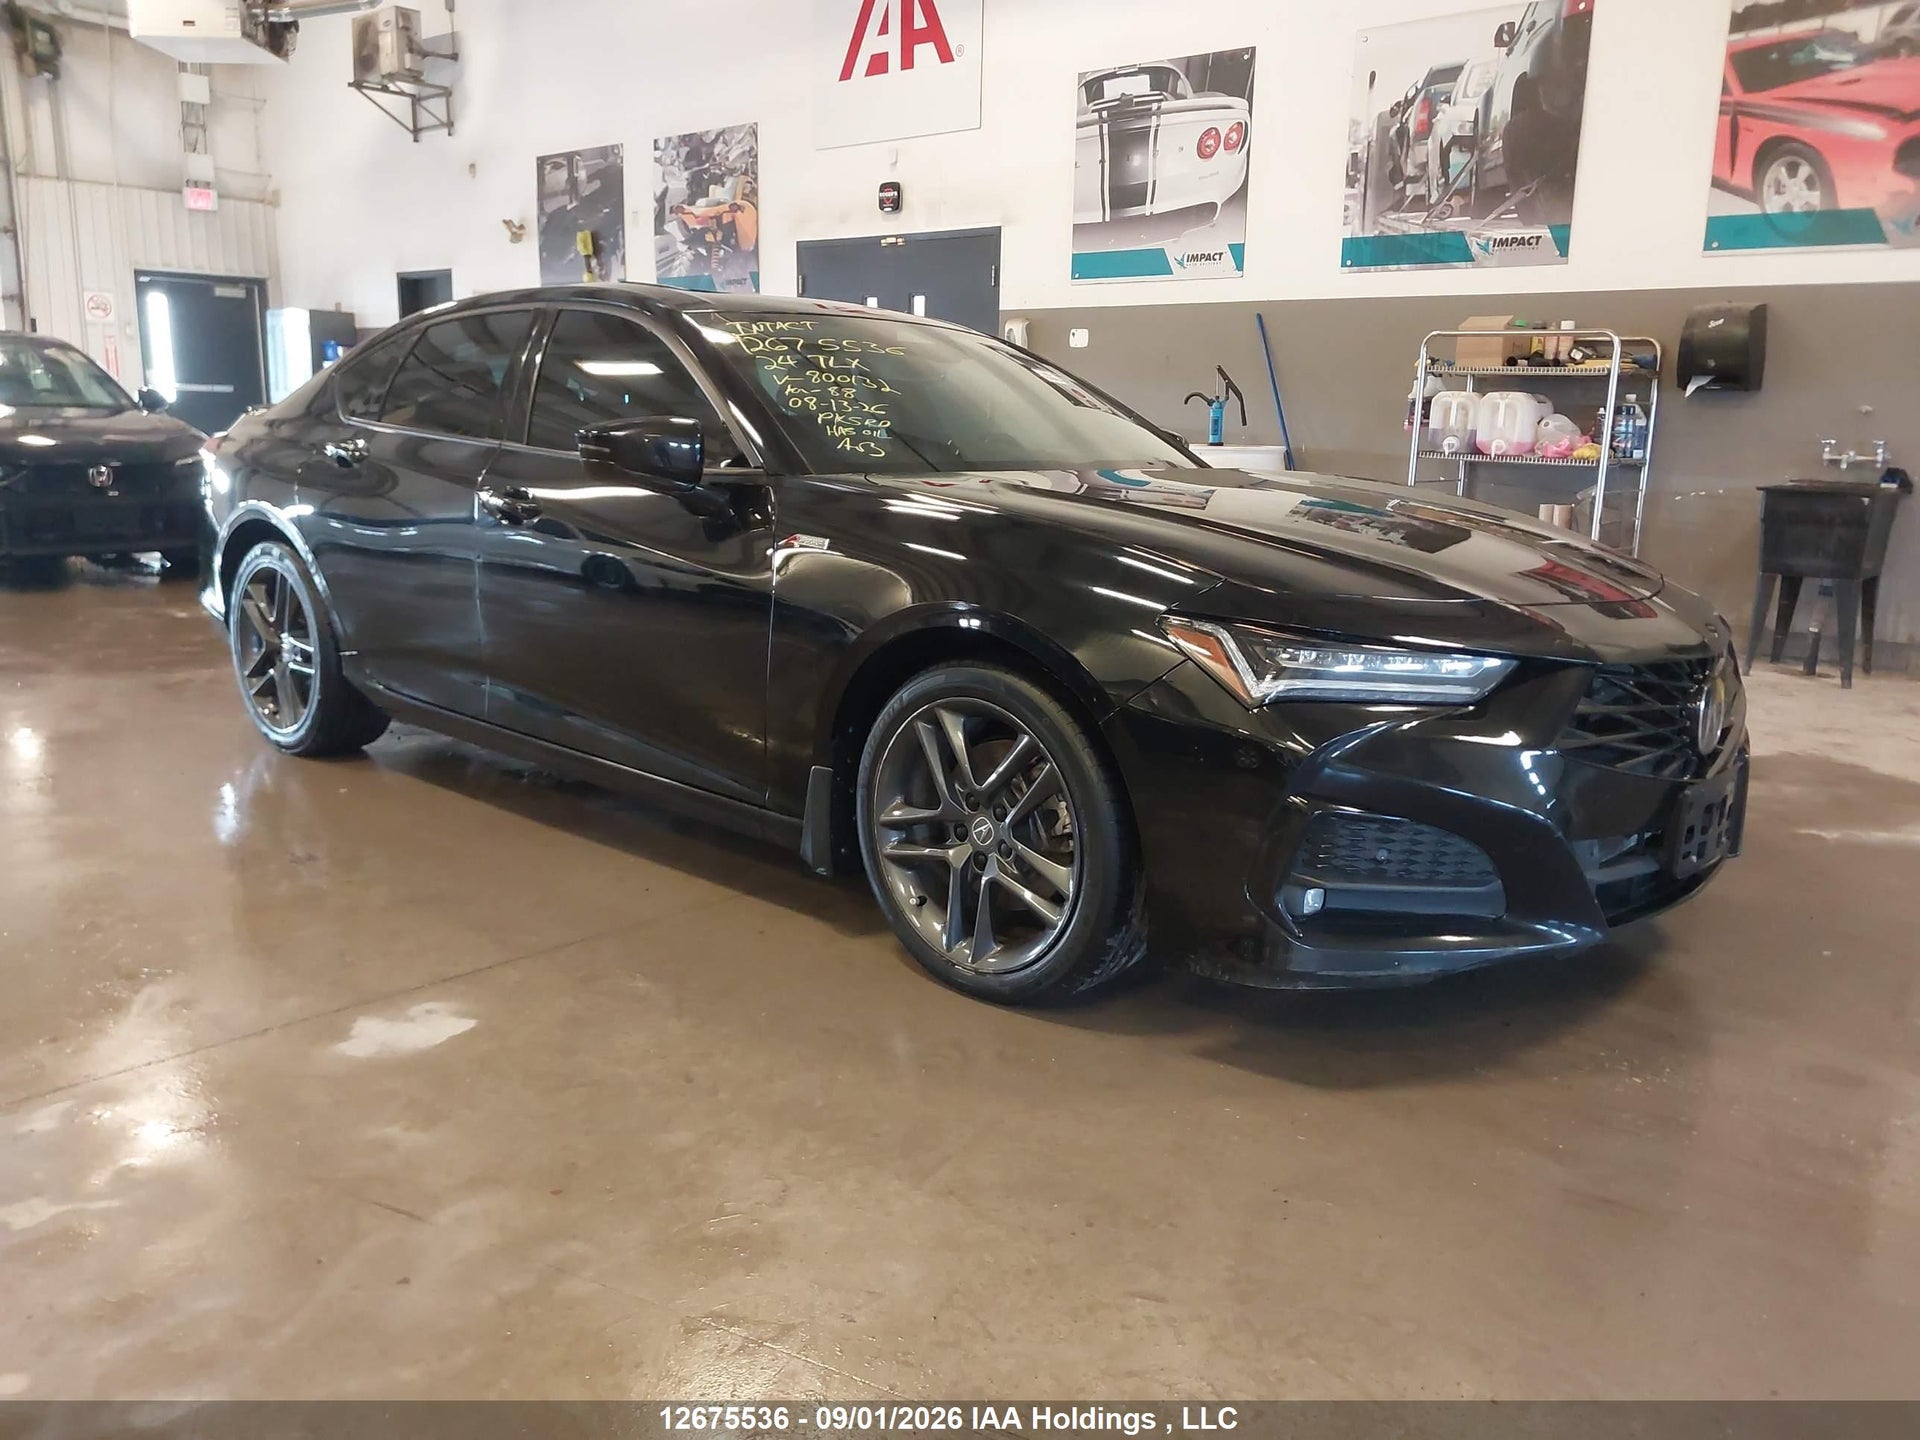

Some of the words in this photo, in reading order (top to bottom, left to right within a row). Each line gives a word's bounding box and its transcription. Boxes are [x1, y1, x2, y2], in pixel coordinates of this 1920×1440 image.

[1491, 235, 1542, 248] IMPACT
[1186, 252, 1223, 263] IMPACT
[726, 320, 820, 335] INTACT
[755, 354, 798, 371] 24
[806, 354, 872, 372] TLX
